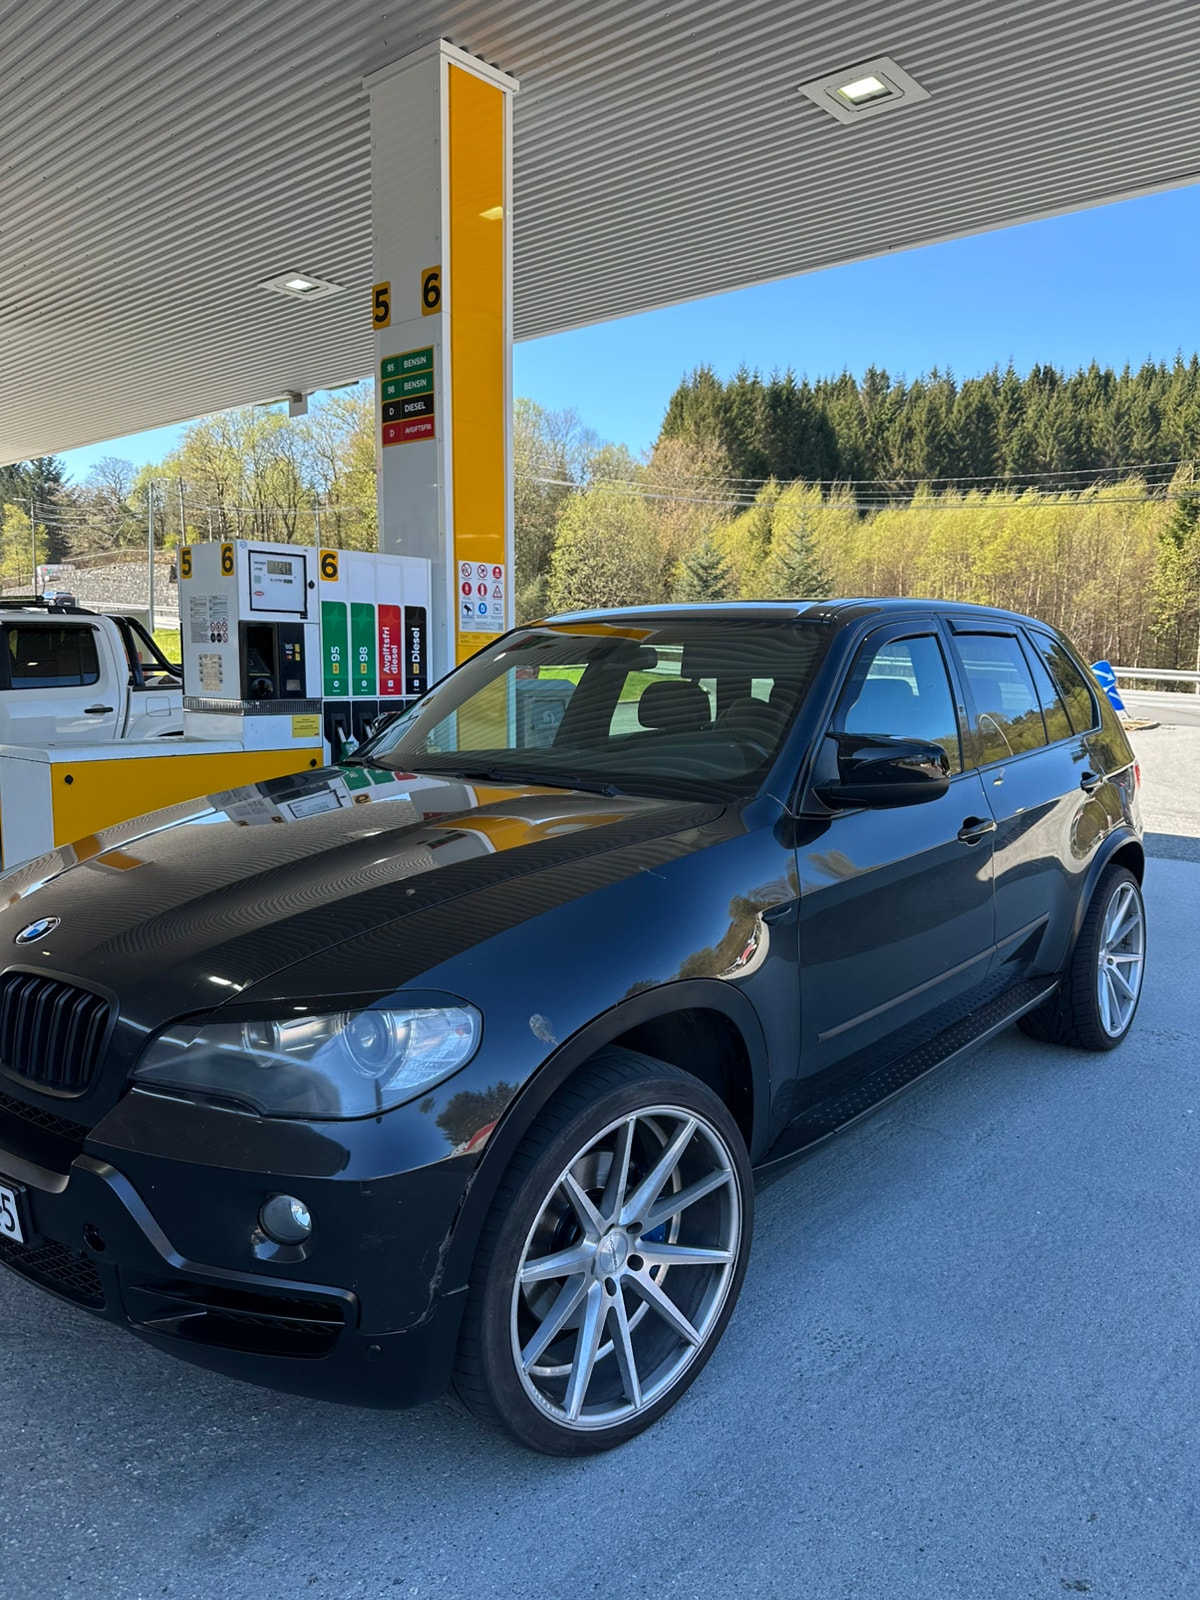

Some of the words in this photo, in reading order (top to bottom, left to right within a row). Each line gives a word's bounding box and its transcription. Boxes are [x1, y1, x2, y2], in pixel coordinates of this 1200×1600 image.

[424, 272, 440, 308] 6
[374, 287, 390, 323] 5
[387, 363, 395, 372] 95
[403, 356, 427, 369] BENSIN
[387, 385, 395, 394] 98
[403, 379, 427, 390] BENSIN
[389, 407, 395, 416] D
[404, 401, 426, 413] DIESEL
[389, 429, 395, 437] D
[181, 550, 192, 576] 5
[222, 547, 234, 573] 6
[321, 553, 338, 579] 6
[330, 645, 340, 662] 95
[359, 646, 368, 662] 98
[382, 626, 391, 674] Avgiftsfri
[411, 627, 420, 663] Diesel
[0, 1192, 16, 1233] 5
